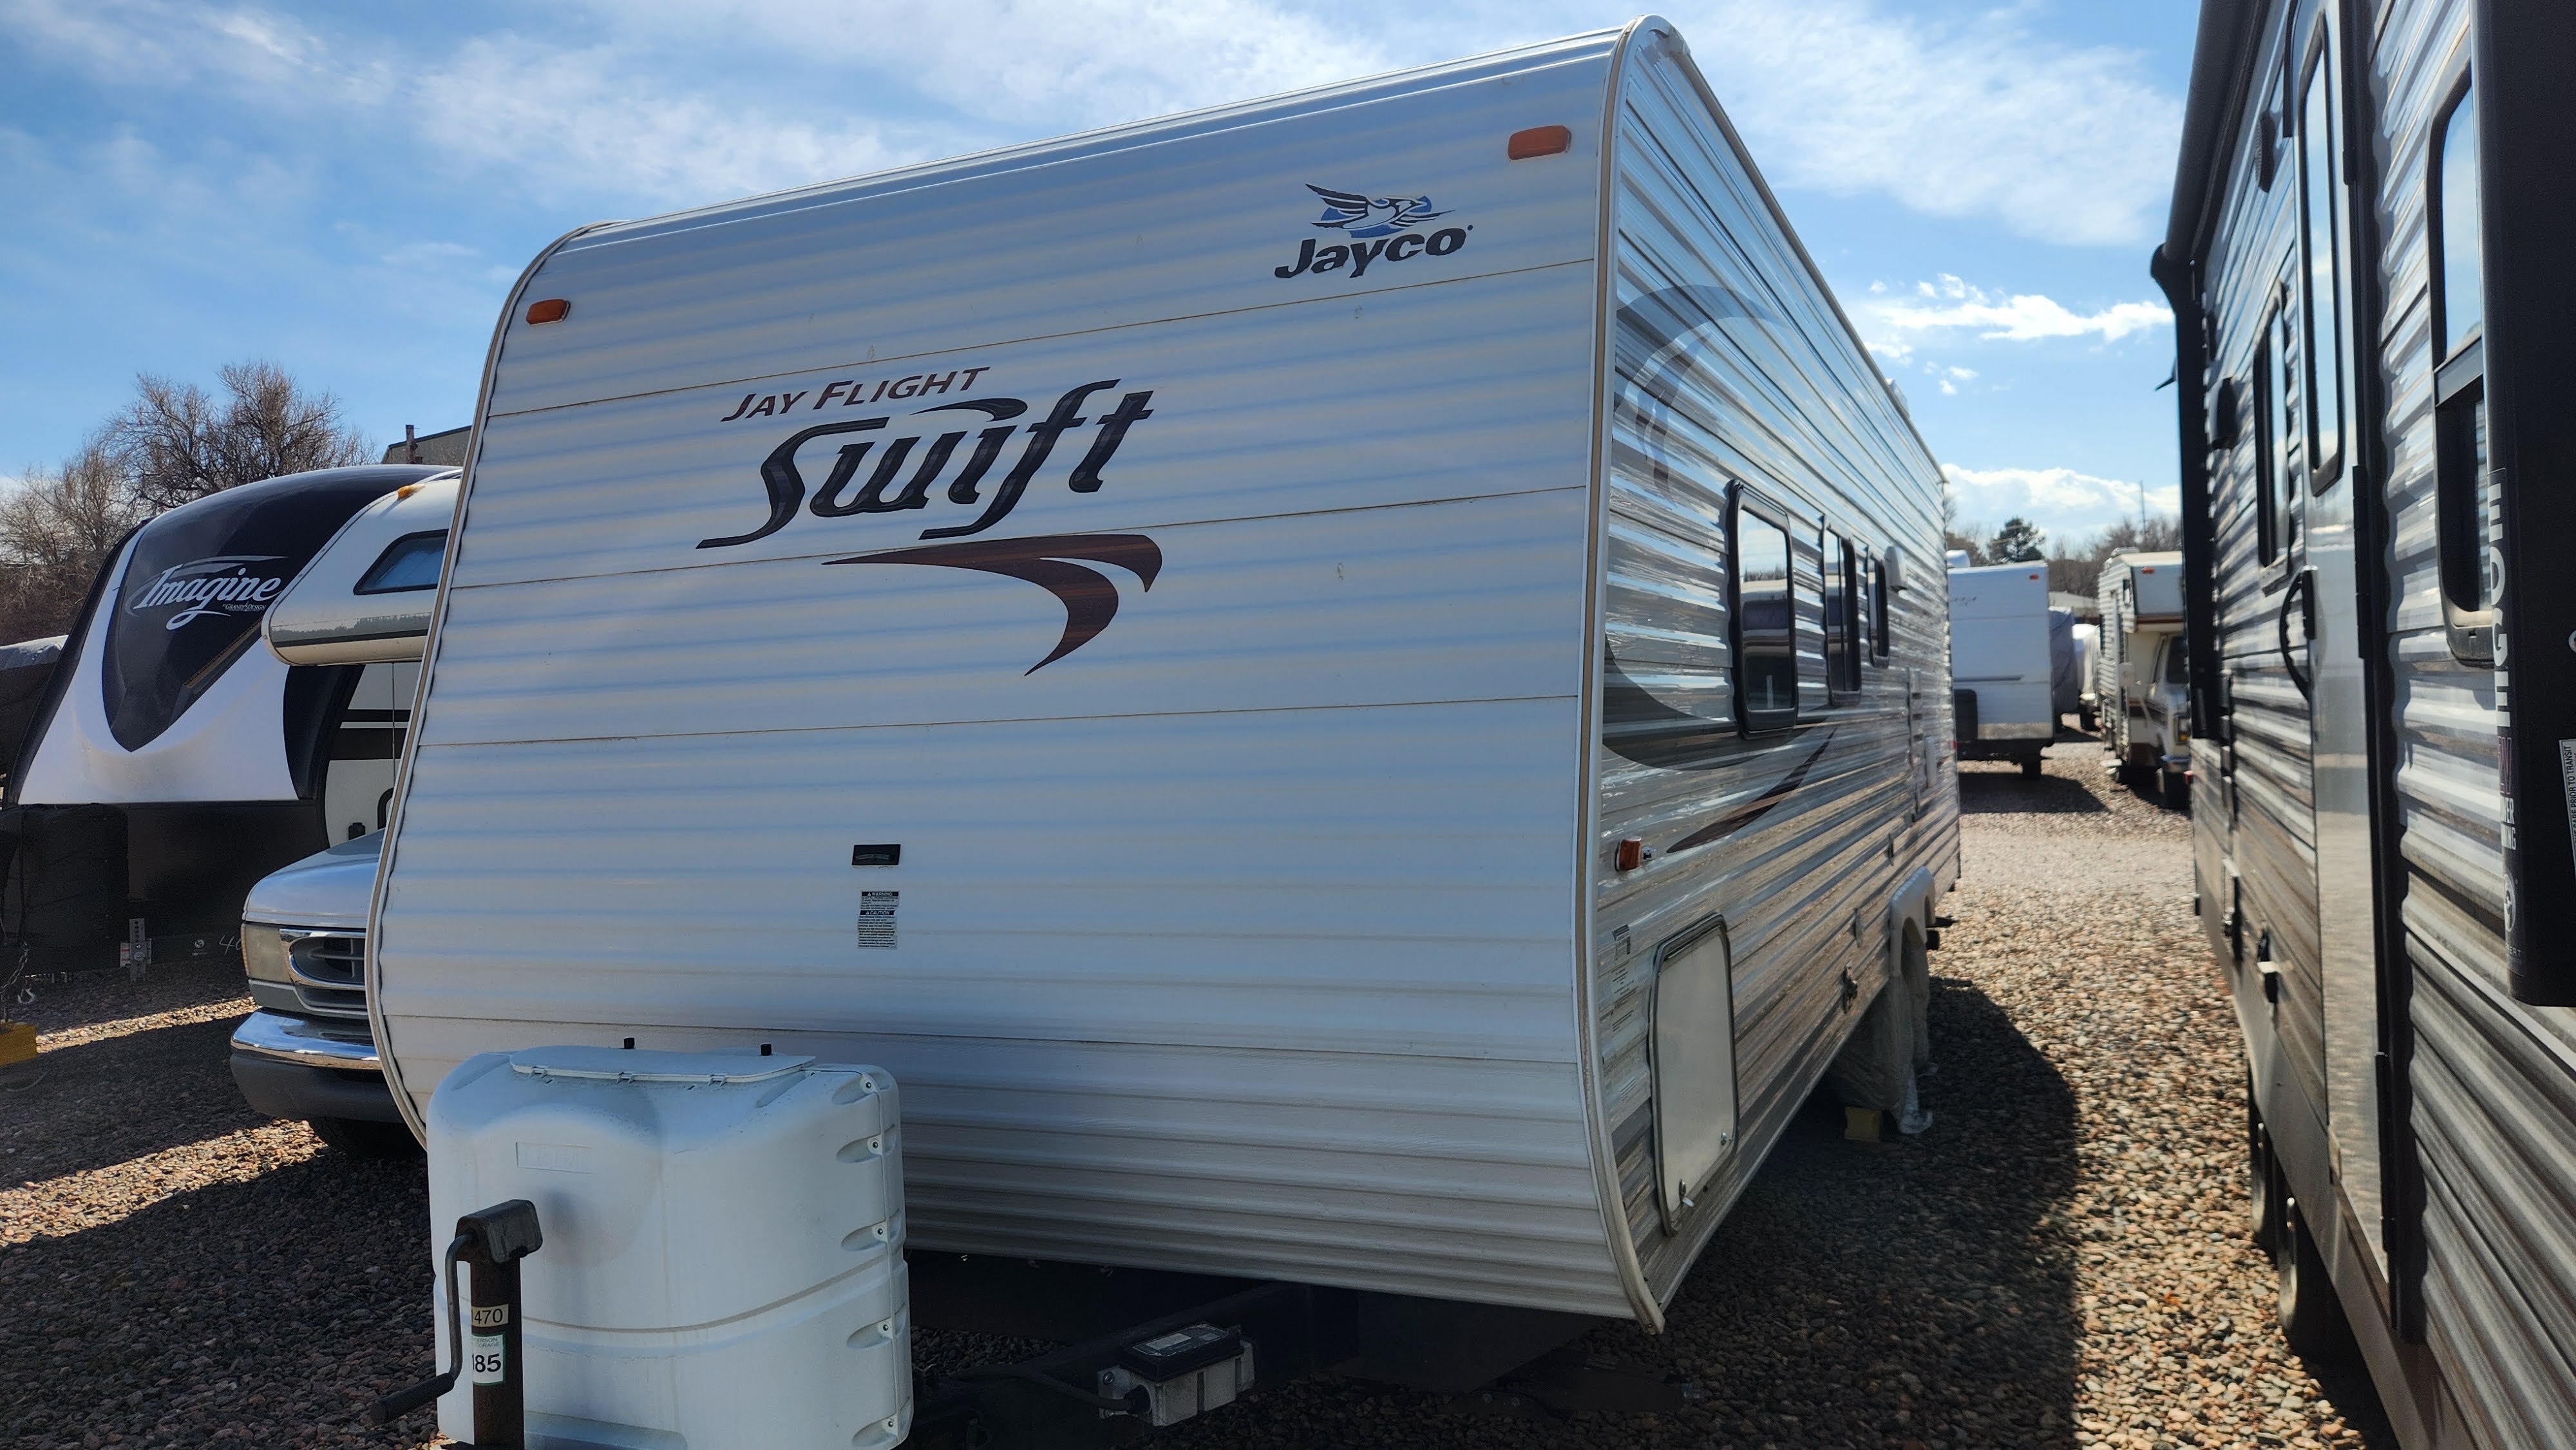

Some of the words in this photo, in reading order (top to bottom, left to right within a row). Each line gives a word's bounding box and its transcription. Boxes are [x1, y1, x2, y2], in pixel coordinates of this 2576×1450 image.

[1274, 227, 1467, 278] Jayco
[720, 390, 809, 422] JAY
[812, 366, 991, 410] FLIGHT
[696, 378, 1154, 549] Swift
[133, 563, 283, 630] Imagine
[2488, 483, 2510, 728] EDGE
[2564, 746, 2574, 775] TRANSIT
[2567, 775, 2576, 786] TO
